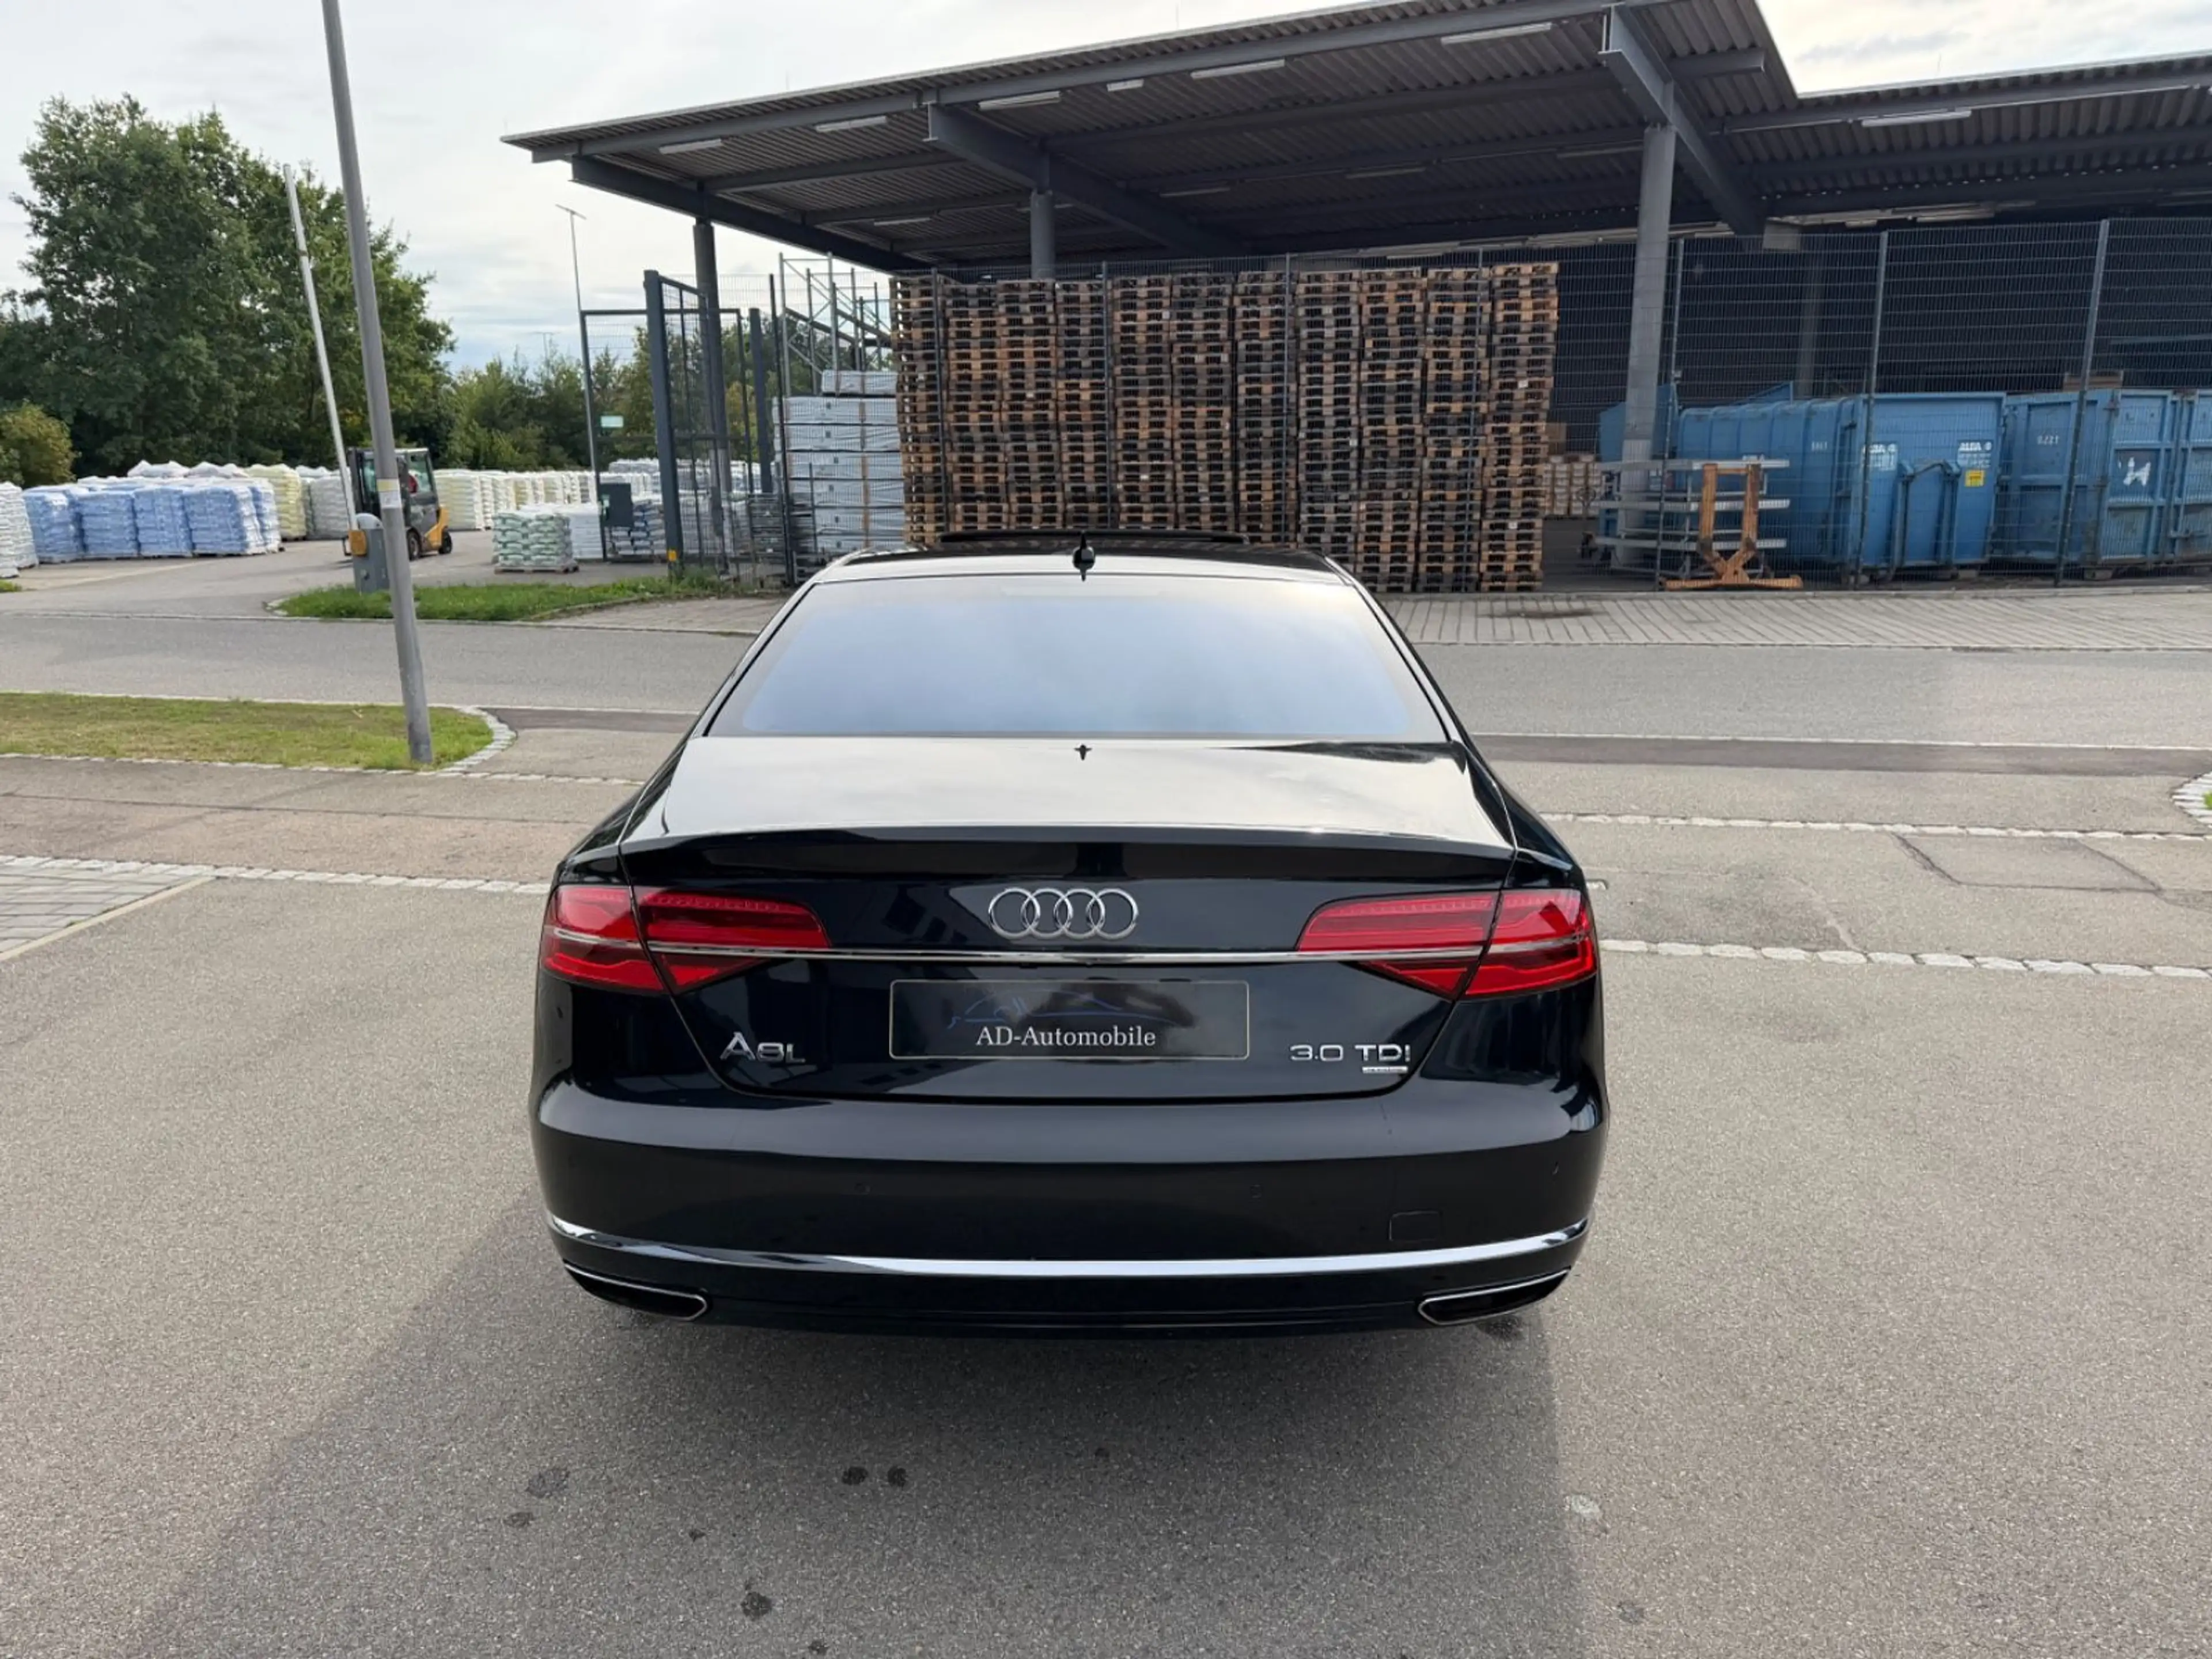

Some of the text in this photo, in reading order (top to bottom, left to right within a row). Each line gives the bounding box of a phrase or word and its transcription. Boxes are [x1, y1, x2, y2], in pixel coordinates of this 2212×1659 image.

[976, 1025, 1156, 1046] AD-Automobile
[719, 1031, 806, 1063] A8L
[1289, 1044, 1411, 1062] 3.0 TDI
